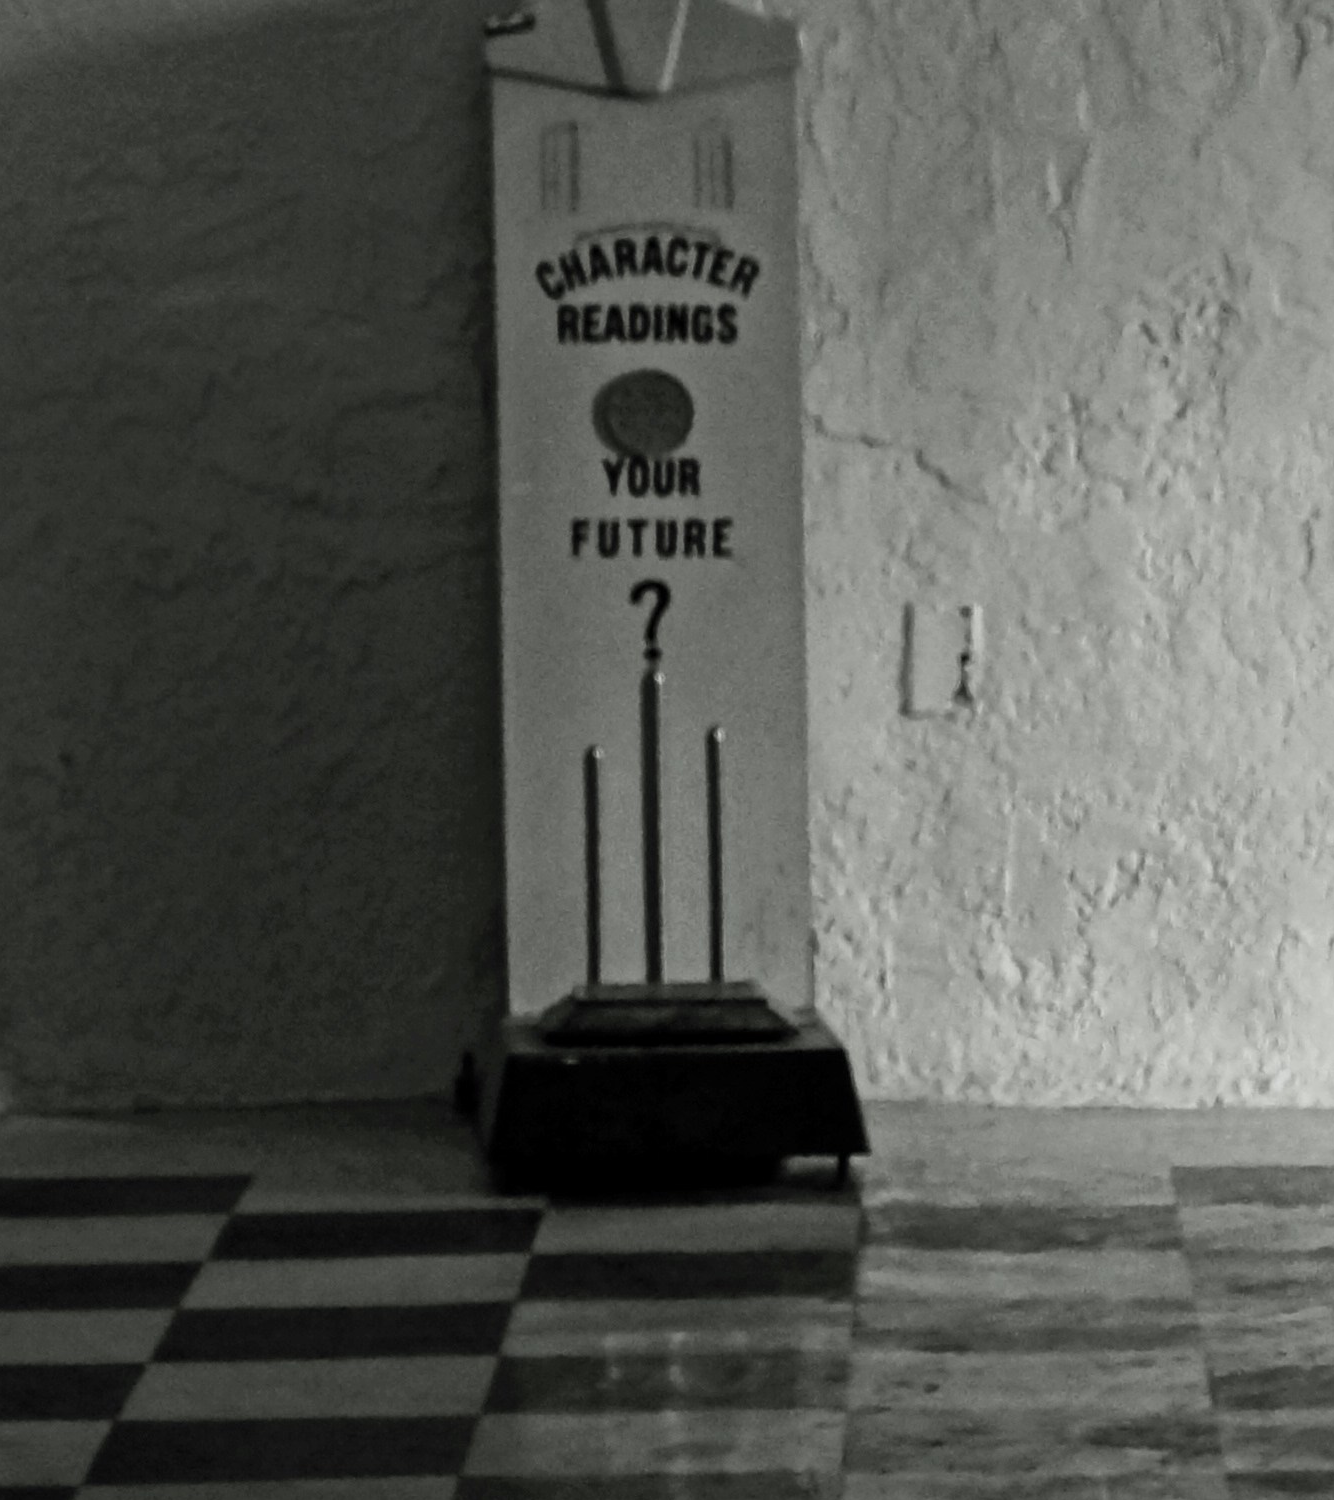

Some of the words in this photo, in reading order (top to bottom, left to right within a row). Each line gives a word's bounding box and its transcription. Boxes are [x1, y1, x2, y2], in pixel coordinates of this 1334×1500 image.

[535, 236, 761, 301] CHARACTER
[557, 304, 738, 344] READINGS
[603, 455, 701, 496] YOUR
[571, 518, 734, 558] FUTURE
